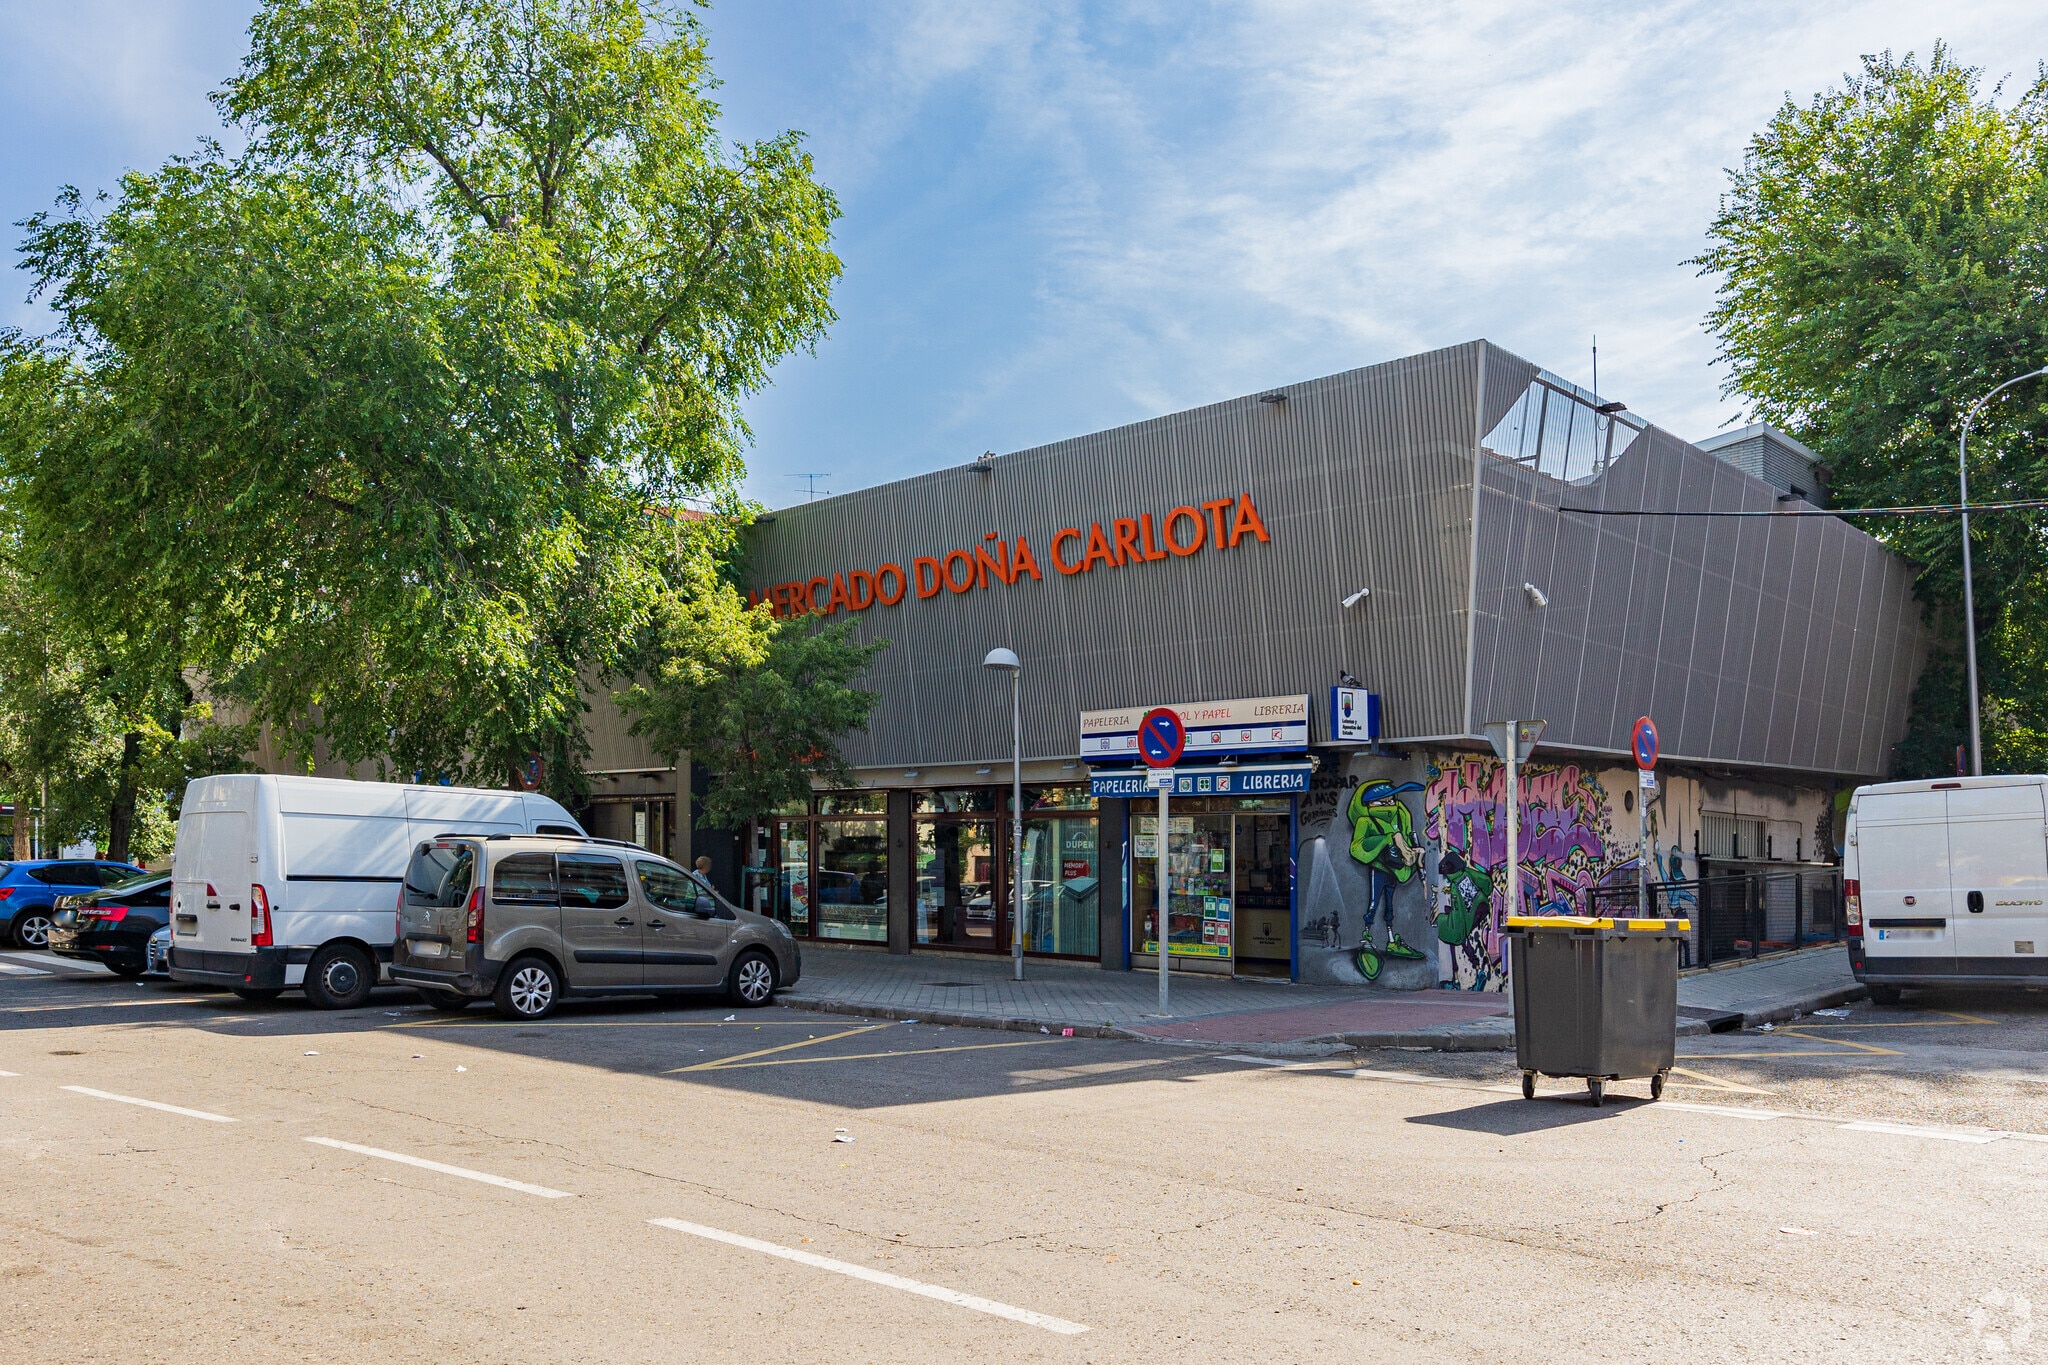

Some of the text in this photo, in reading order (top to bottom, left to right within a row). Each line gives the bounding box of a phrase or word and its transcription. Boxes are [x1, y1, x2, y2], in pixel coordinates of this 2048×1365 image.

[914, 530, 1042, 600] DOÑA
[1050, 491, 1270, 576] CARLOTA
[1083, 715, 1130, 728] PAPELERIA
[1193, 710, 1201, 720] Y
[1202, 707, 1232, 720] PAPEL
[1254, 703, 1305, 717] LIBRERIA
[1093, 773, 1304, 794] PAPELERIA LIBRERIA
[1066, 840, 1094, 849] DUPEN
